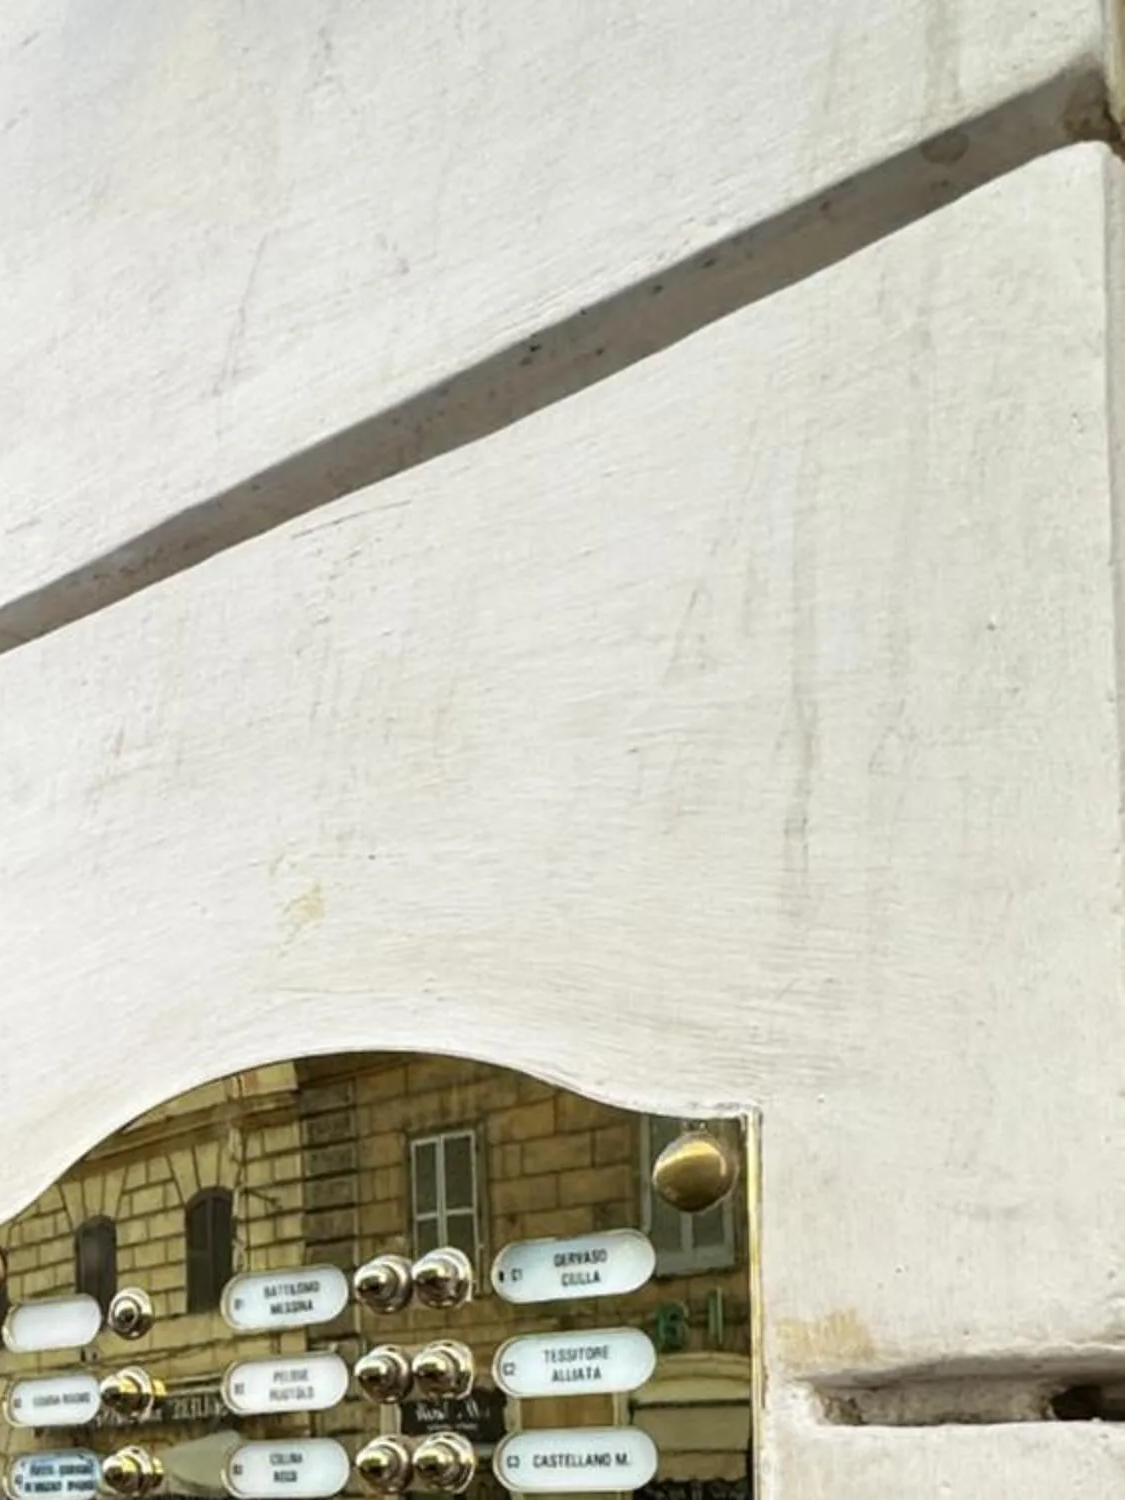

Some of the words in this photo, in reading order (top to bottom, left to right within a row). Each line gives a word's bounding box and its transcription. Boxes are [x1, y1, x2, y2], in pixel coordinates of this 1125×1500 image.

[553, 1249, 609, 1268] GERVASO
[544, 1345, 610, 1363] TESSITORE
[551, 1366, 602, 1383] ALLIATA
[533, 1453, 612, 1469] CASTELLANO
